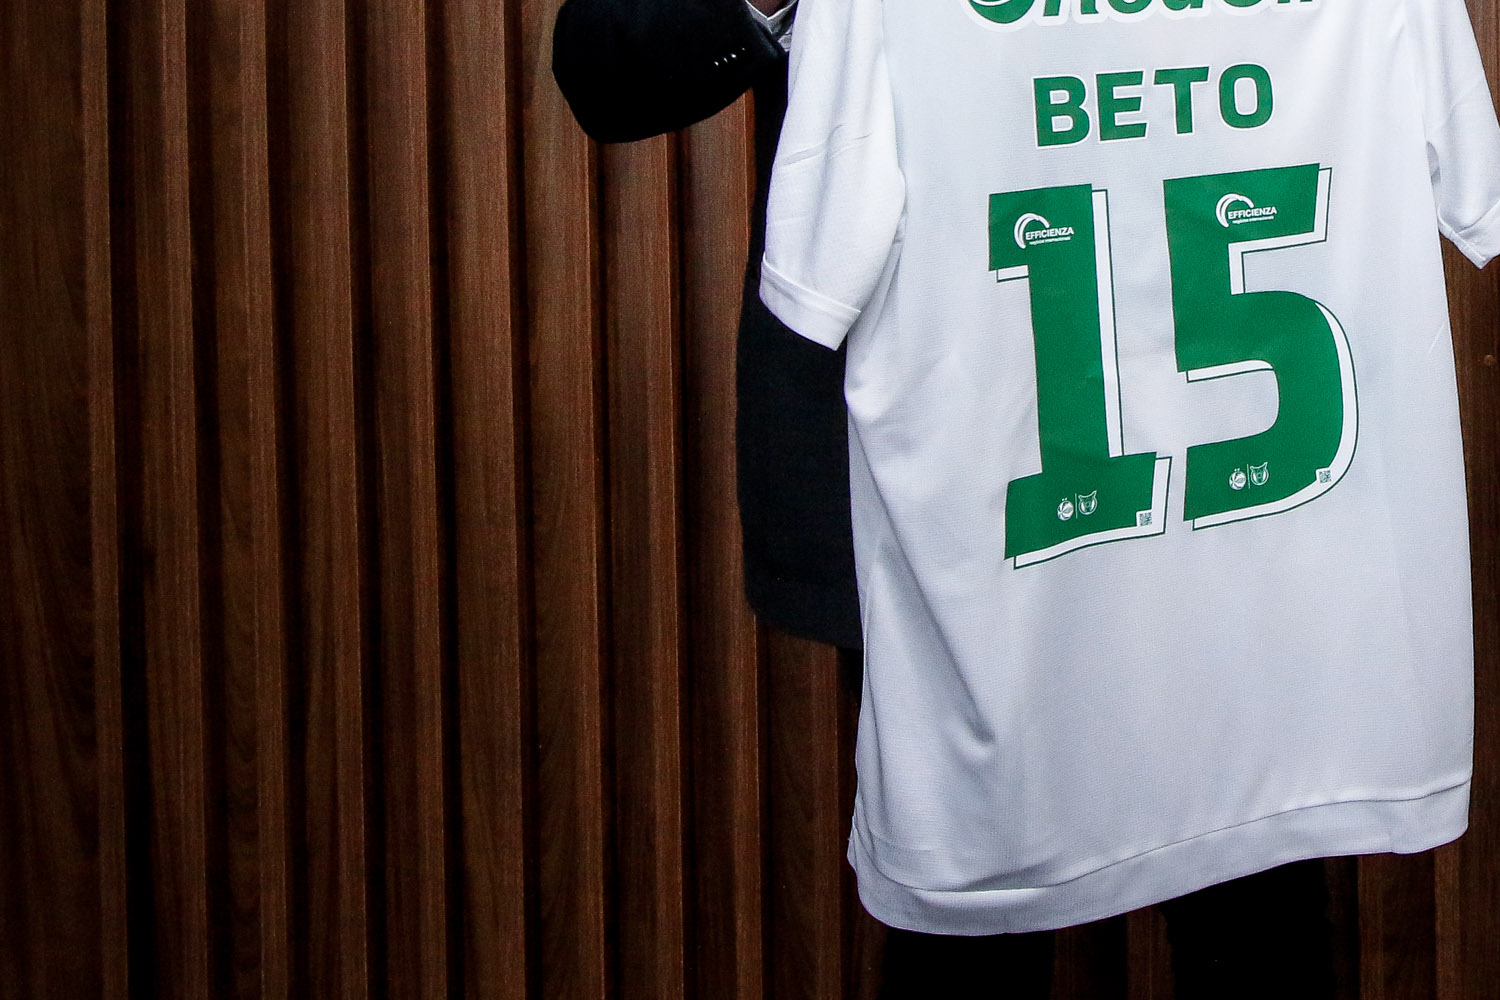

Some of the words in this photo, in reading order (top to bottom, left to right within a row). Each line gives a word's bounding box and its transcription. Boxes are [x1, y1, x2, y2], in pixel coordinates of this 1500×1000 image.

[1034, 64, 1273, 146] BETO
[1025, 226, 1075, 241] EFFICIENZA
[1227, 206, 1278, 220] EFFICIENZA
[988, 162, 1359, 570] 15
